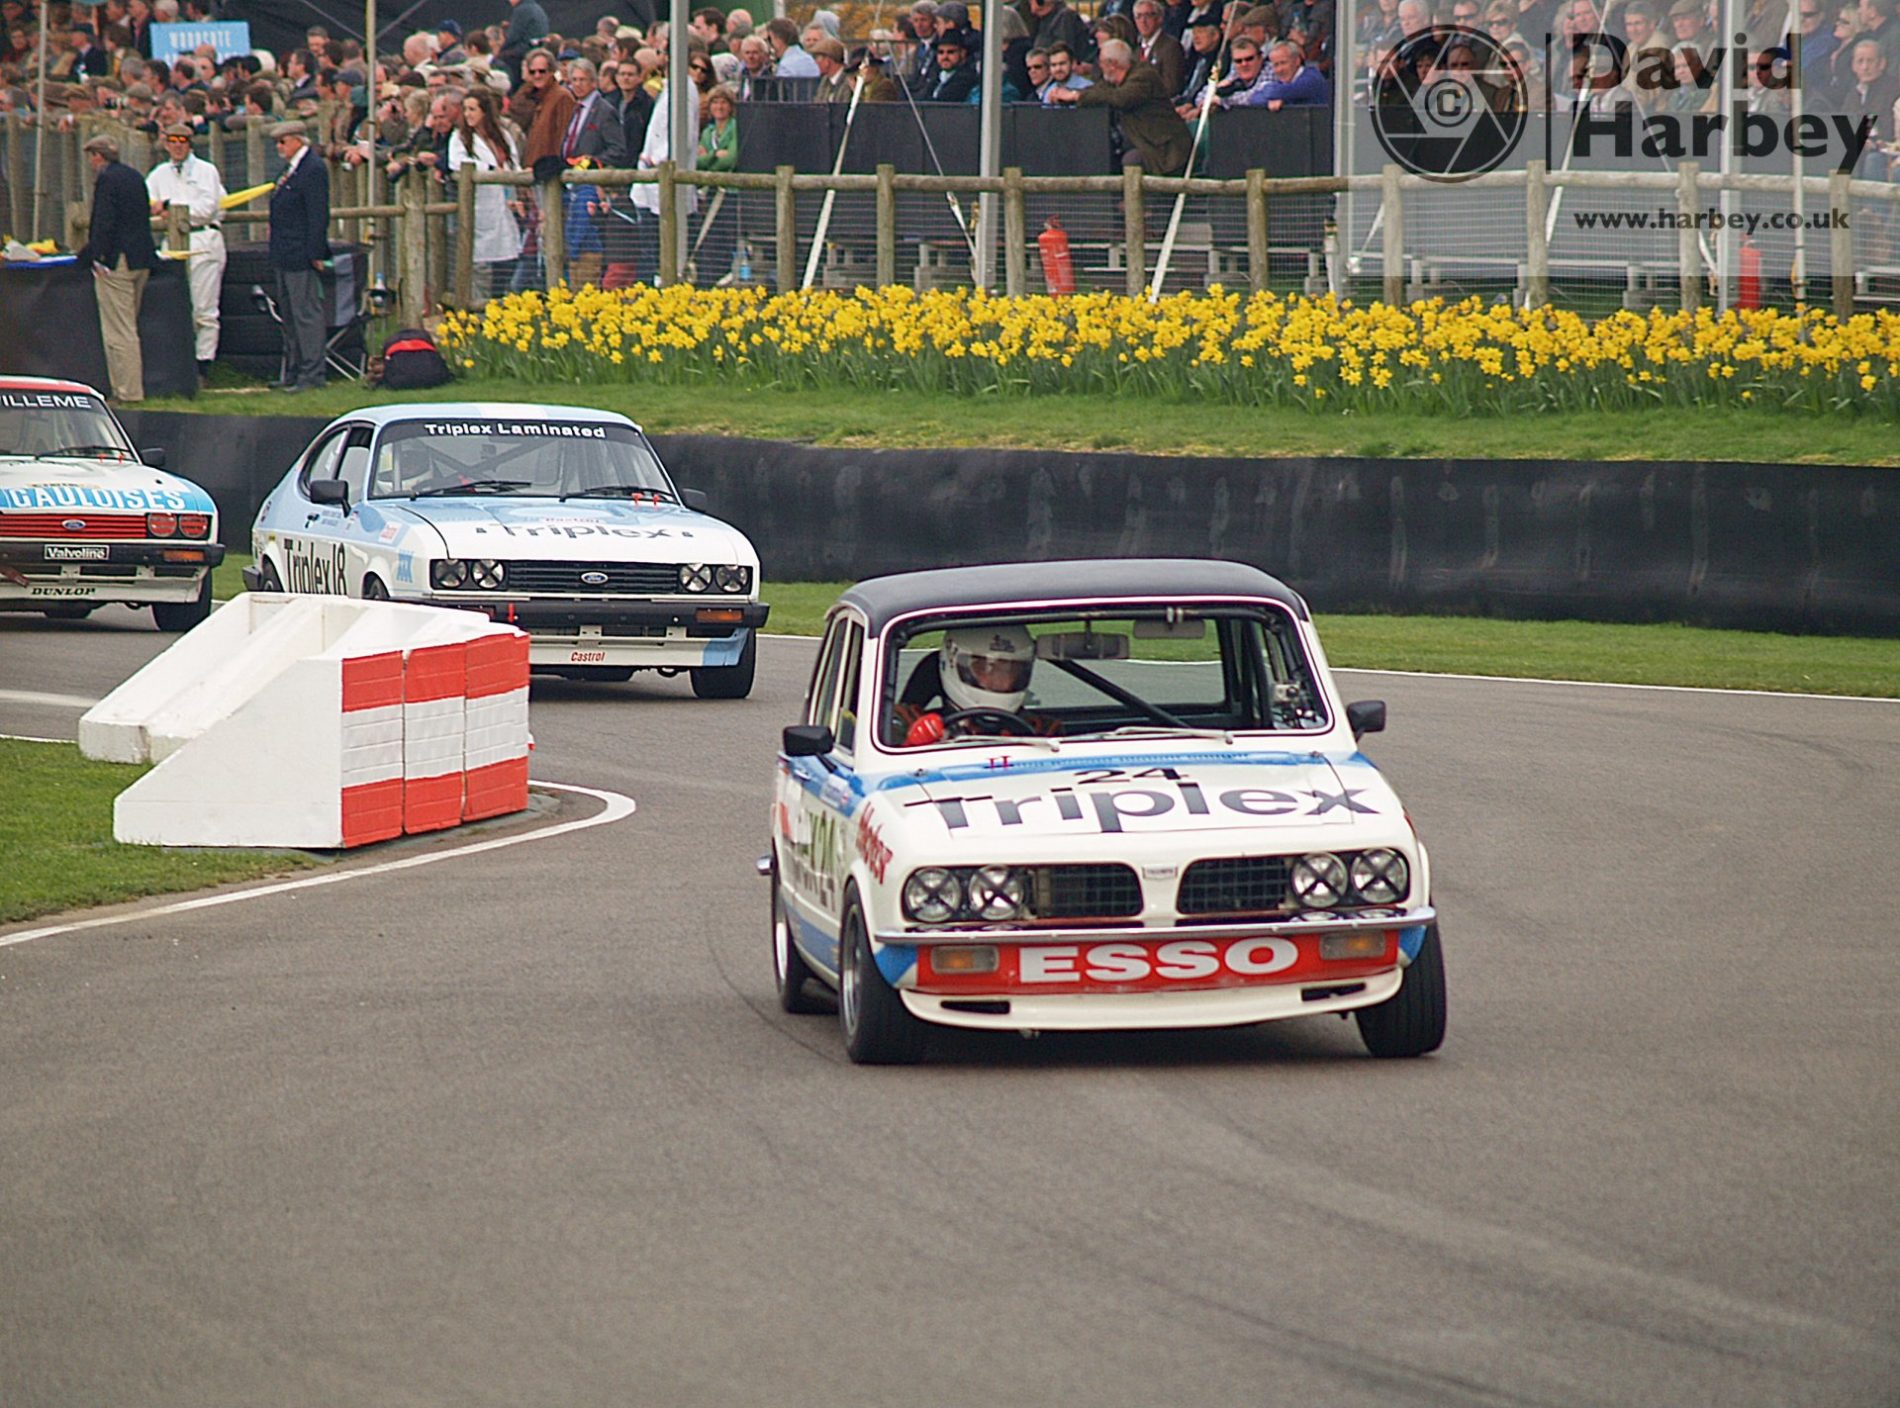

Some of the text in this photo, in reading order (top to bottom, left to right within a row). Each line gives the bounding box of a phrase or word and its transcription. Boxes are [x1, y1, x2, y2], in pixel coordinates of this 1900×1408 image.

[0, 395, 92, 408] ILLEME
[424, 423, 606, 438] Triplex Laminated
[10, 487, 186, 510] GAULOISES
[489, 524, 673, 539] Triplex
[48, 547, 106, 559] Valvoline
[31, 587, 95, 596] DUNLOP
[570, 651, 606, 662] Castrol
[1073, 768, 1189, 784] 24
[903, 782, 1381, 833] Triplex
[1019, 936, 1299, 983] ESSO
